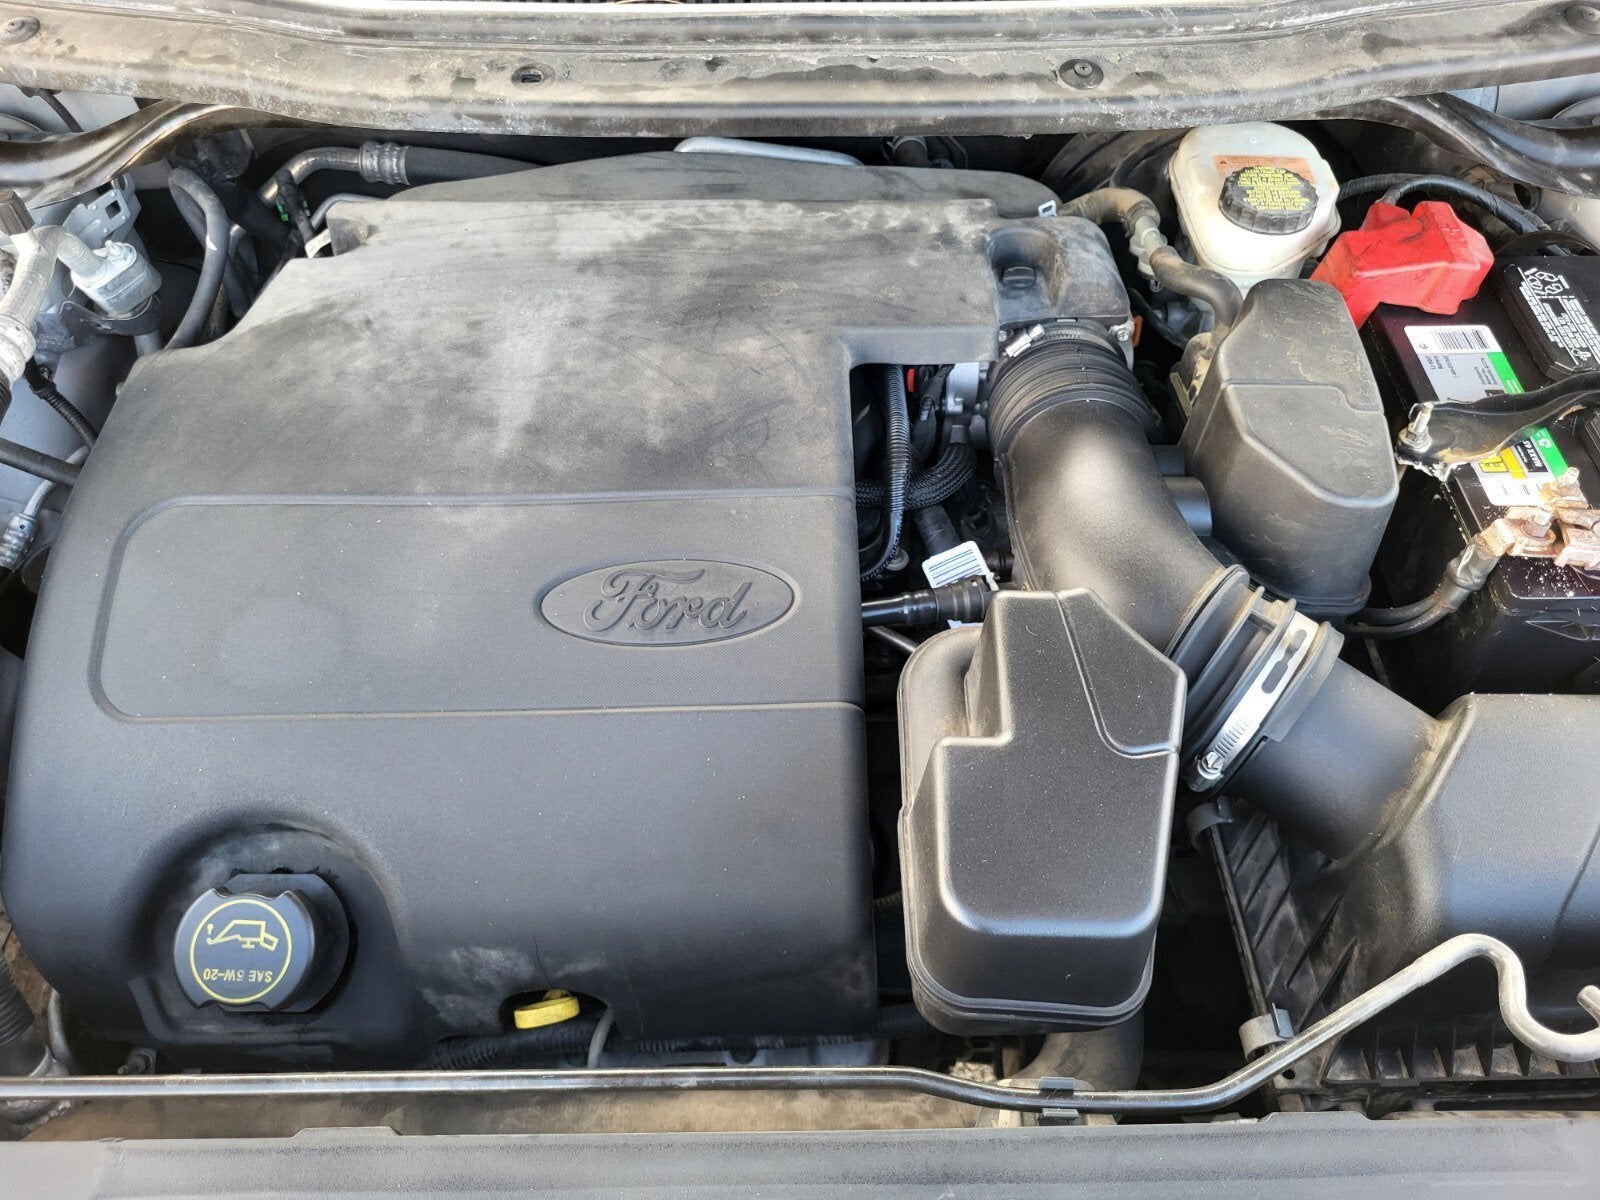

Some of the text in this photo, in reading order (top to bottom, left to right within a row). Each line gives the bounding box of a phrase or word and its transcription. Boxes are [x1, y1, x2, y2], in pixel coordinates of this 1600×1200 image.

[583, 569, 753, 632] Ford
[203, 968, 274, 983] SAE 5W-20
